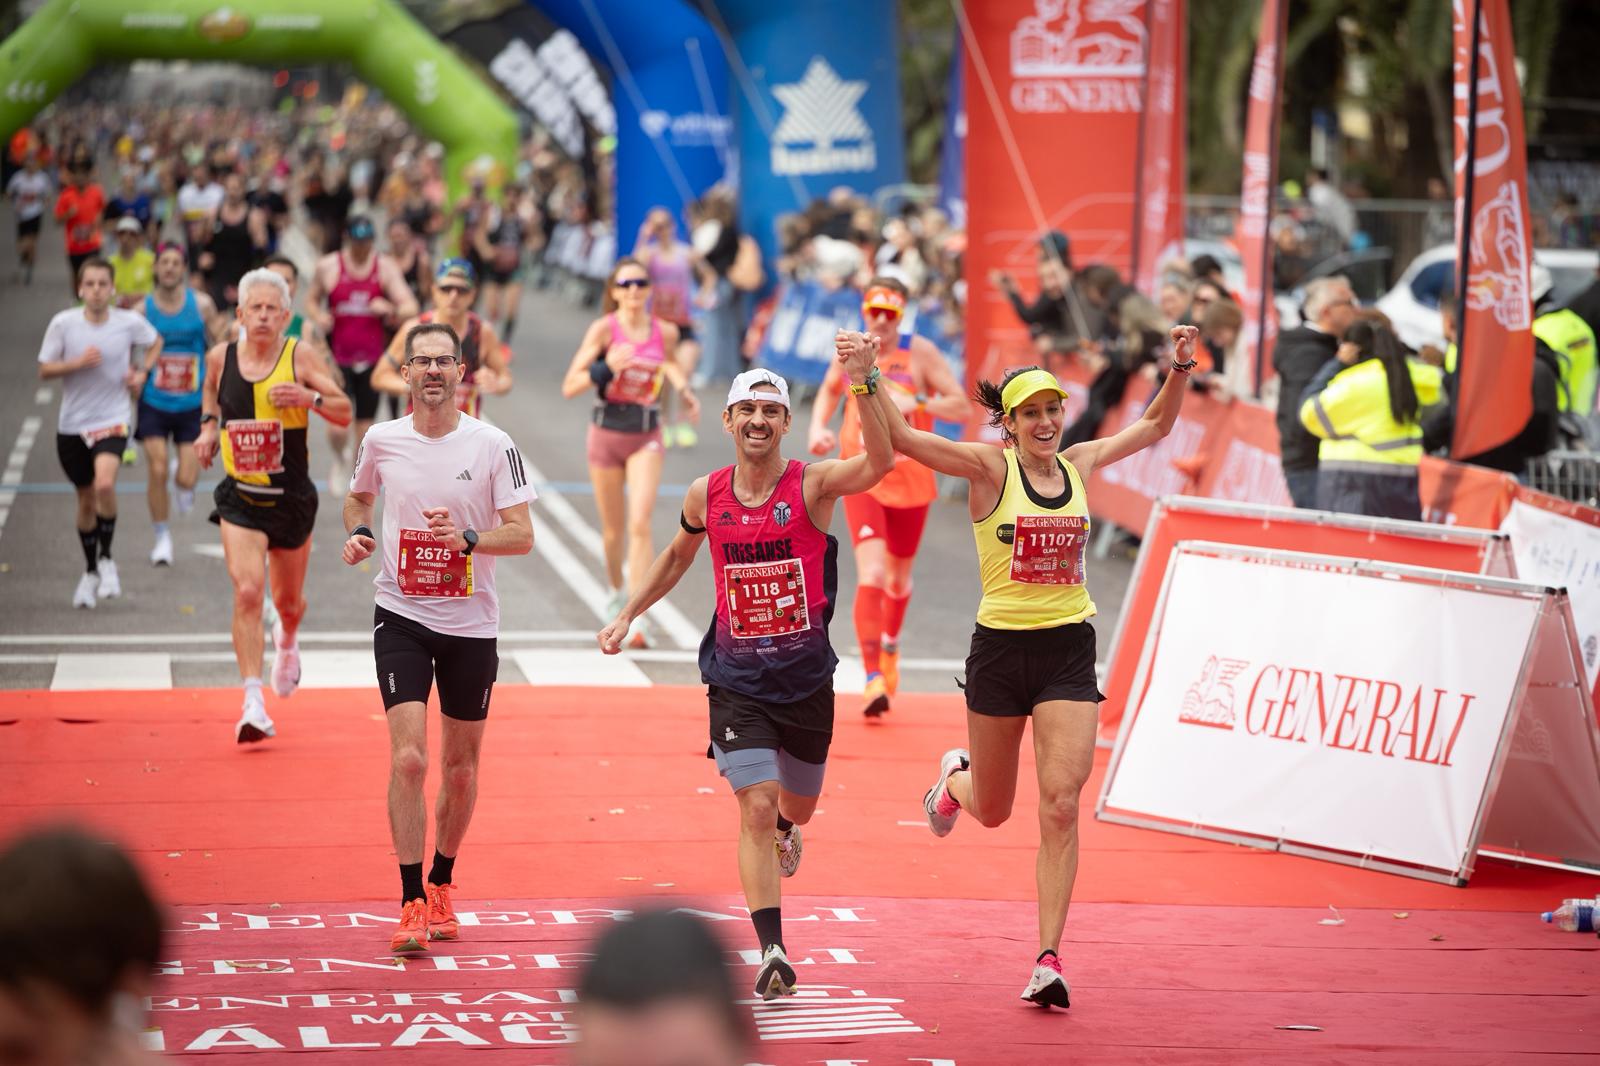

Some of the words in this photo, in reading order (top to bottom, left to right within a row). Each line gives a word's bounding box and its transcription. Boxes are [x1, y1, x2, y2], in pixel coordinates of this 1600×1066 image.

[236, 433, 265, 446] 1419
[1036, 517, 1081, 527] GENERALI
[1030, 533, 1075, 547] 11107
[415, 547, 451, 561] 2675
[742, 564, 790, 579] GENERALI
[743, 582, 780, 598] 1118
[1246, 664, 1476, 767] GENERALI
